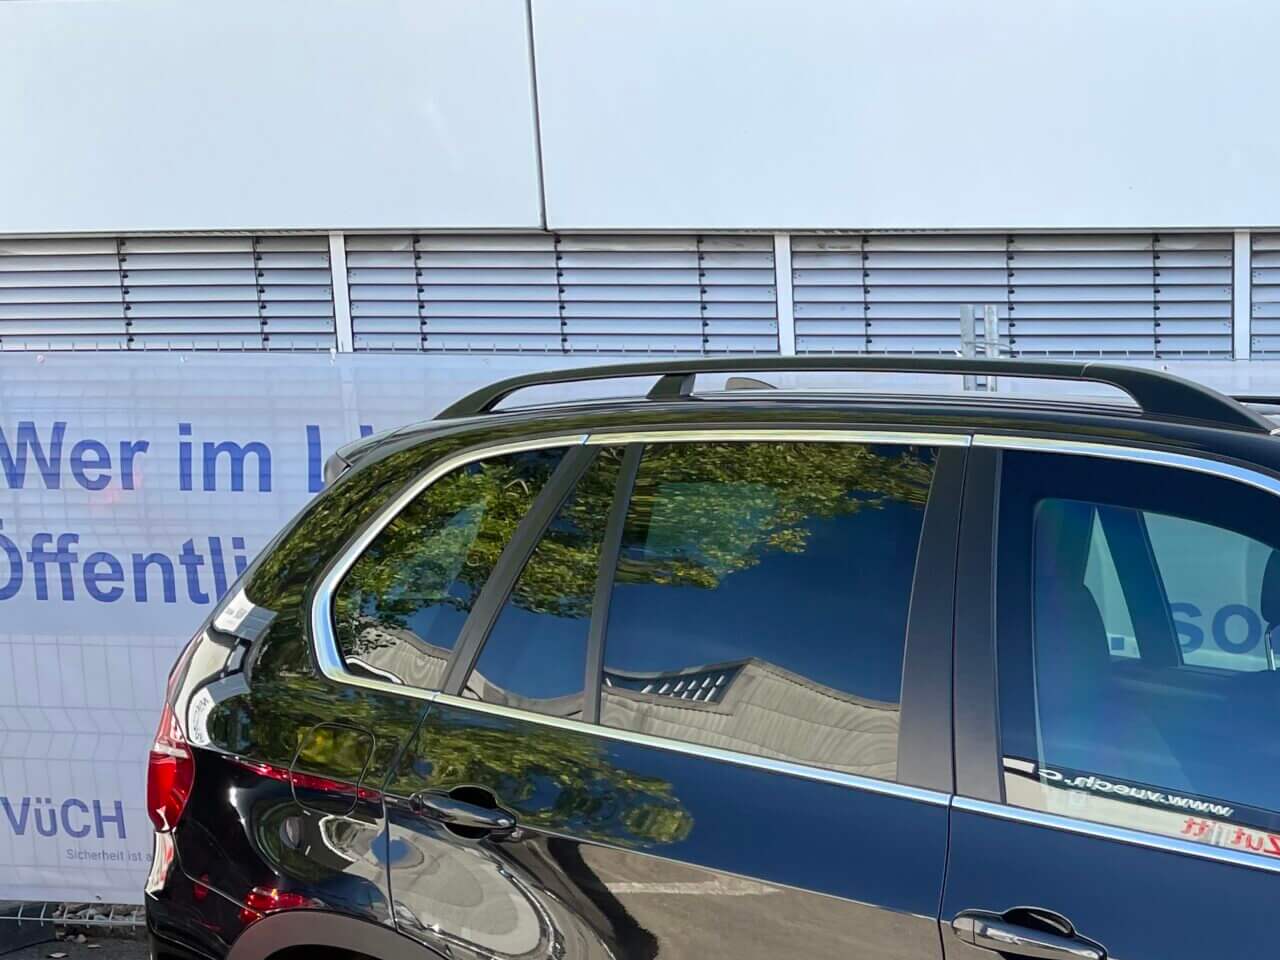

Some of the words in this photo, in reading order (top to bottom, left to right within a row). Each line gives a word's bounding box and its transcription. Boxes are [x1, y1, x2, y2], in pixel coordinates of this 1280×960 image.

[0, 421, 150, 491] Wer
[178, 422, 272, 493] im
[0, 796, 127, 840] VüCH
[65, 848, 125, 862] Sicherheit
[127, 849, 143, 863] ist
